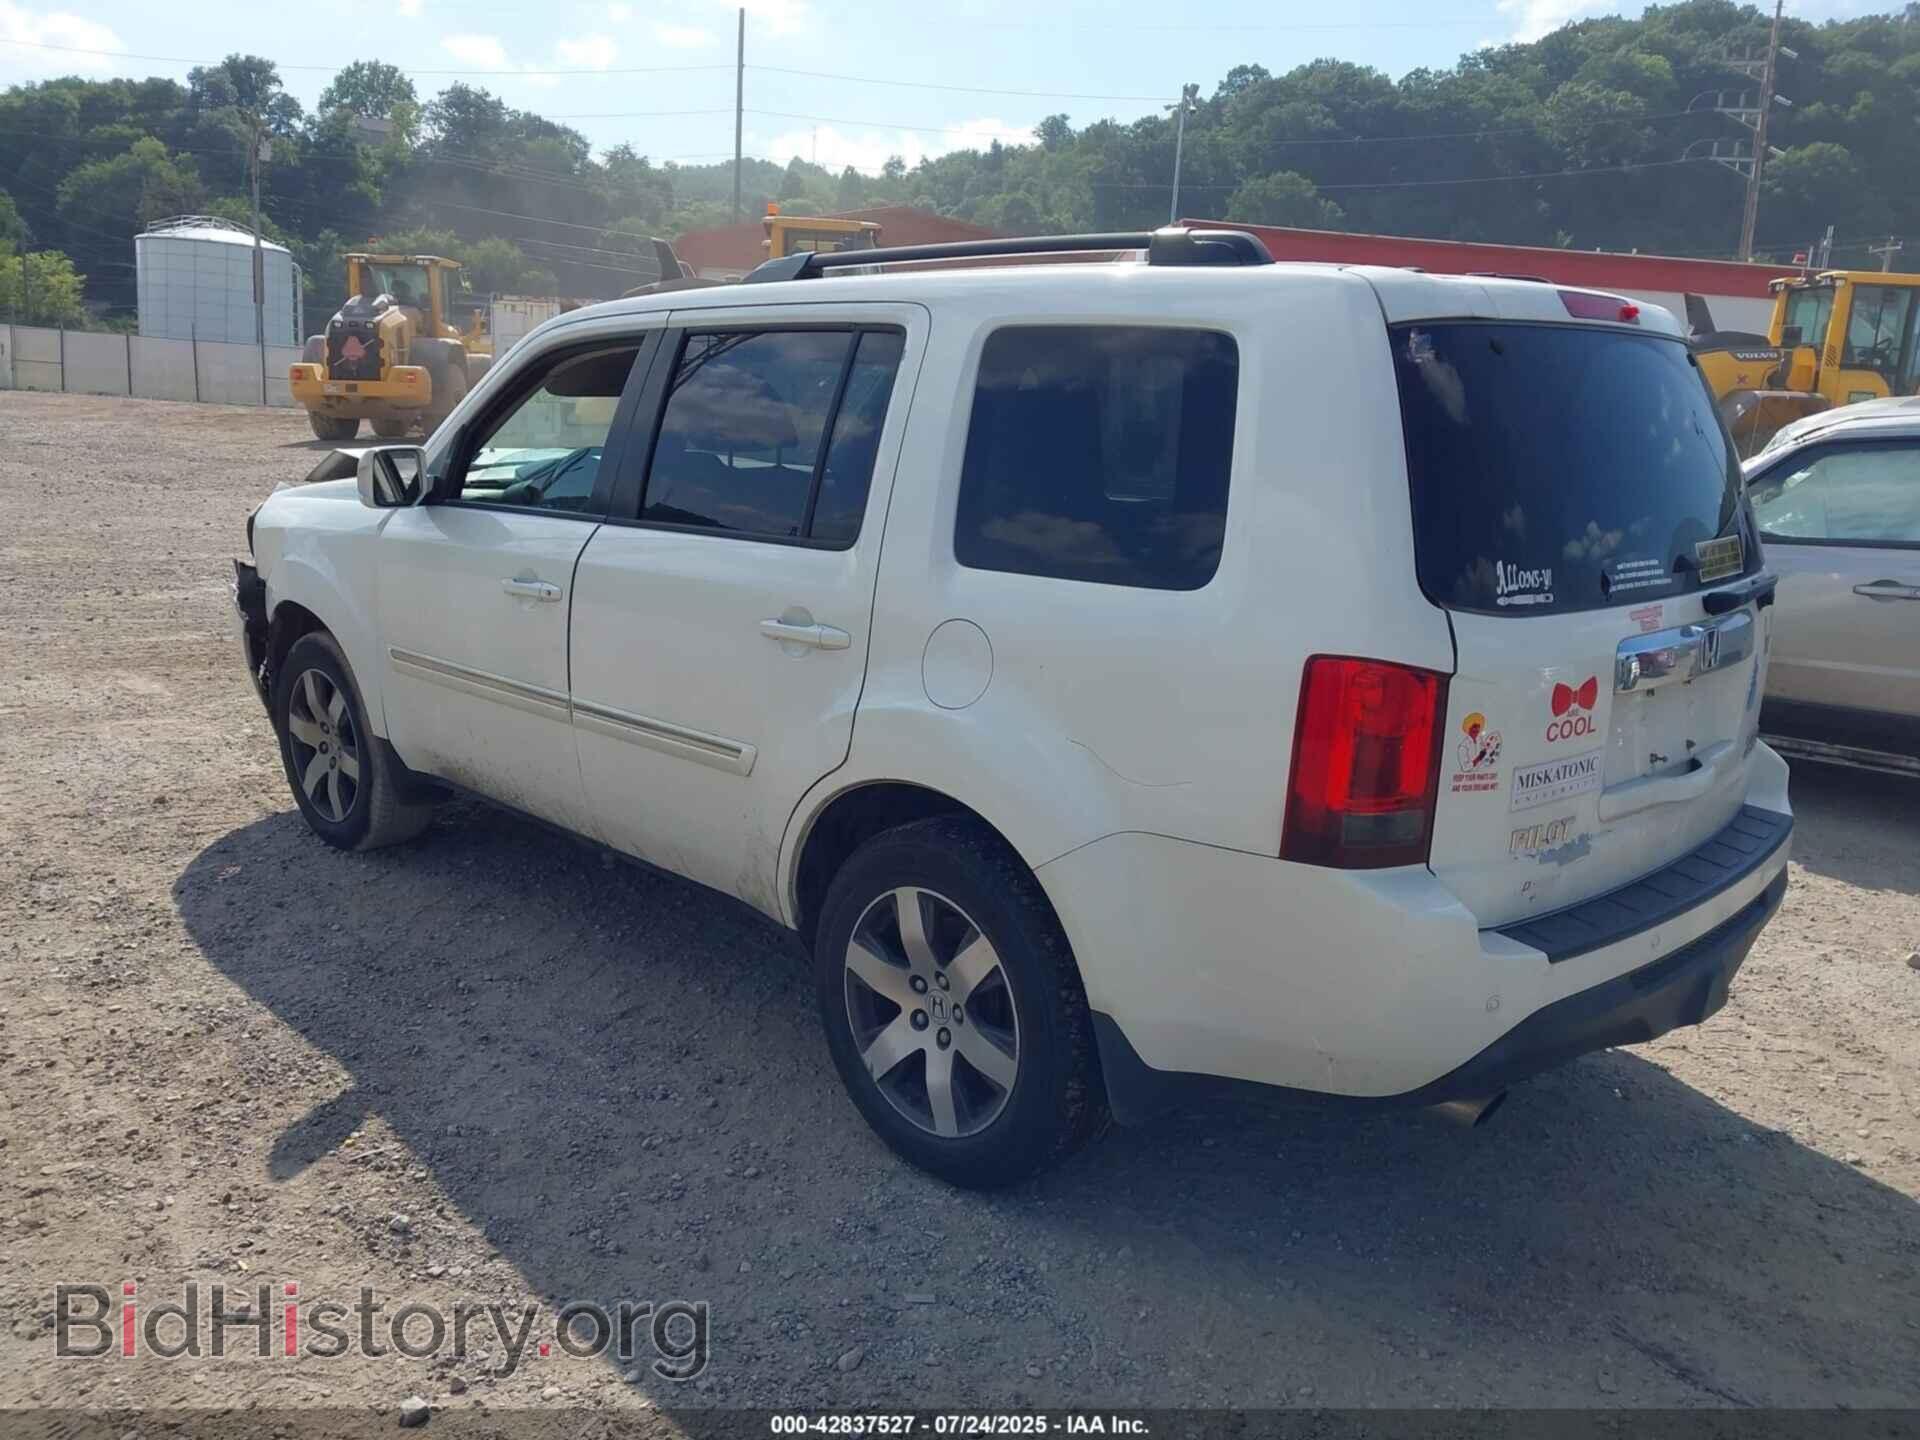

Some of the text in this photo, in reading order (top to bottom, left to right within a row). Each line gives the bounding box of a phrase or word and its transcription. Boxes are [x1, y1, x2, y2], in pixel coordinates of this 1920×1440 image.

[1736, 351, 1778, 360] VOLVO
[1546, 716, 1596, 742] COOL
[1518, 756, 1600, 789] MISKATONIC
